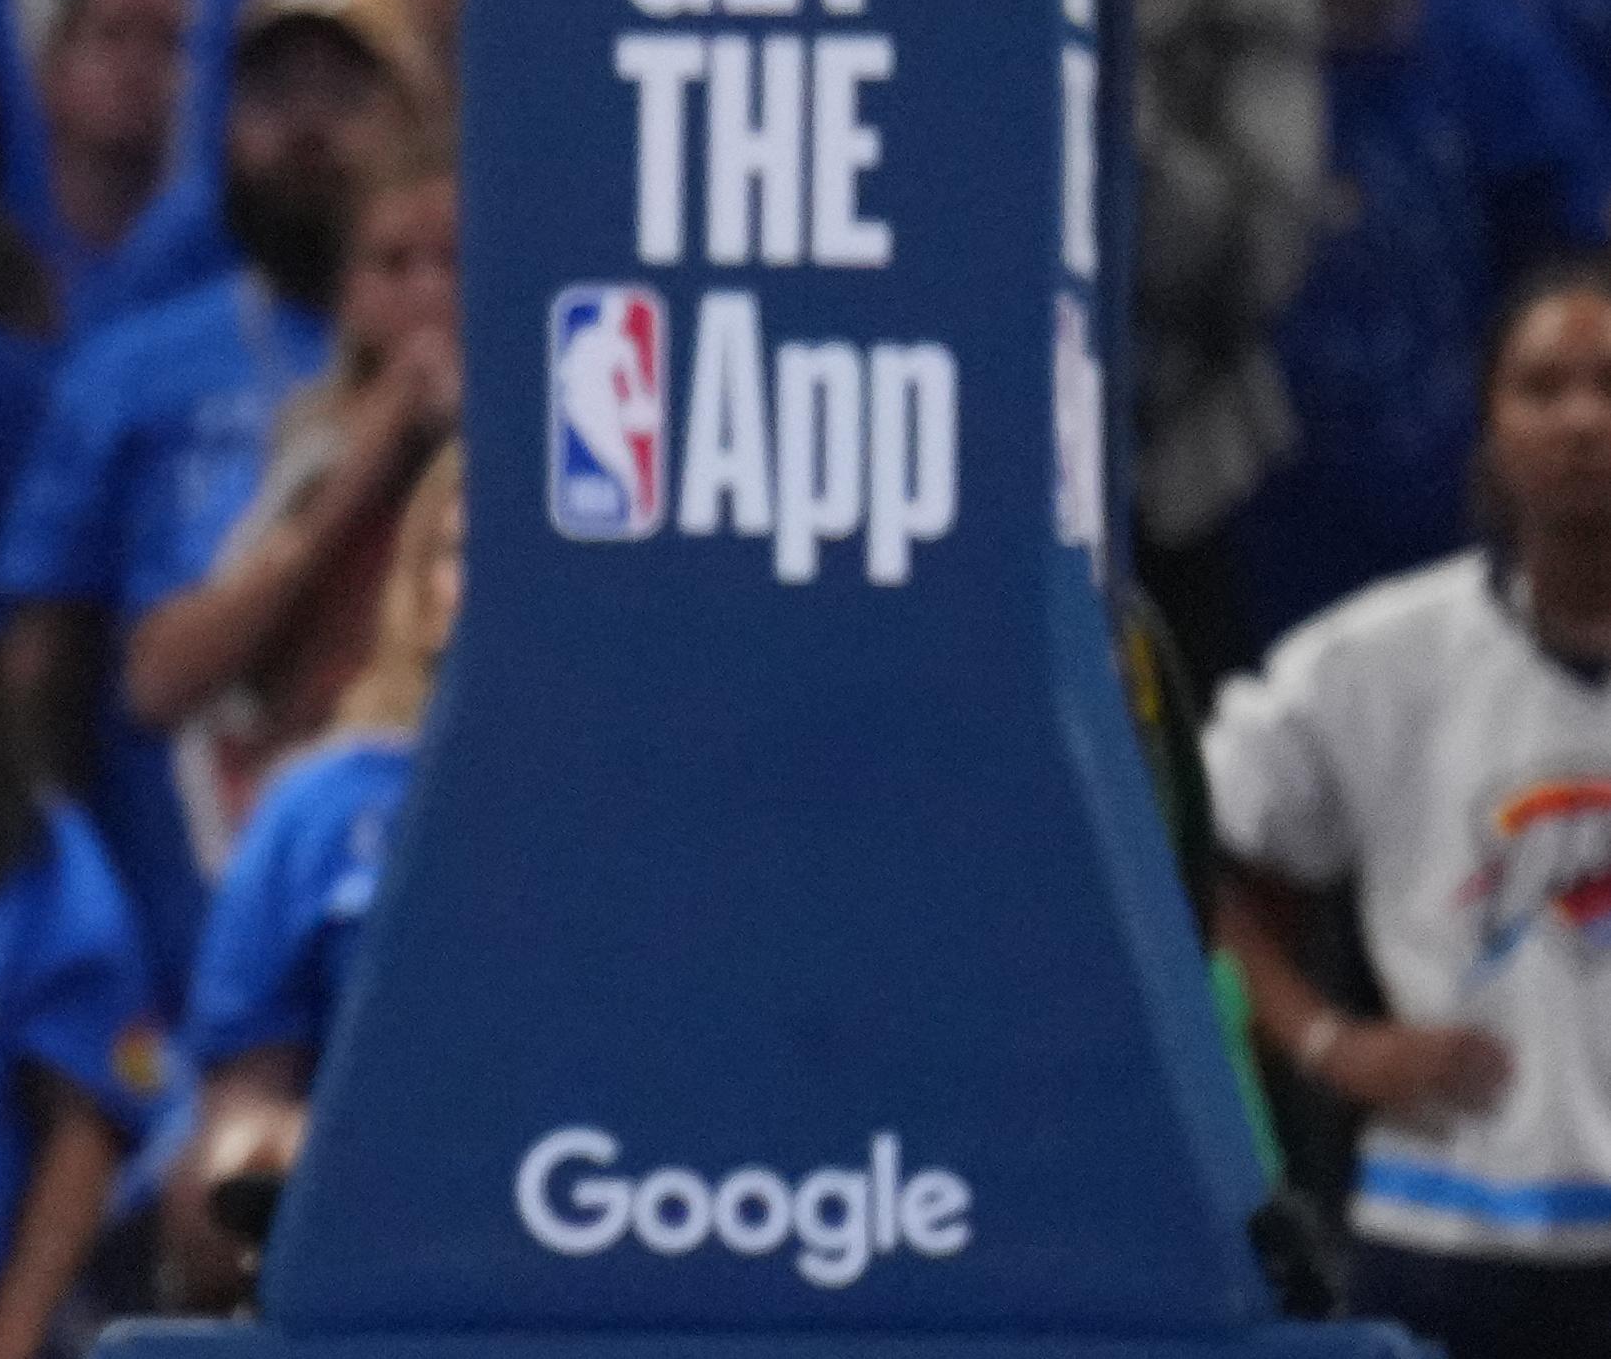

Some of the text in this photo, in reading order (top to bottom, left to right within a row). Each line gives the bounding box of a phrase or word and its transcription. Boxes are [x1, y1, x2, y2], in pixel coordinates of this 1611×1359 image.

[613, 35, 896, 267] THE
[677, 290, 958, 586] App
[513, 1126, 973, 1289] Google
